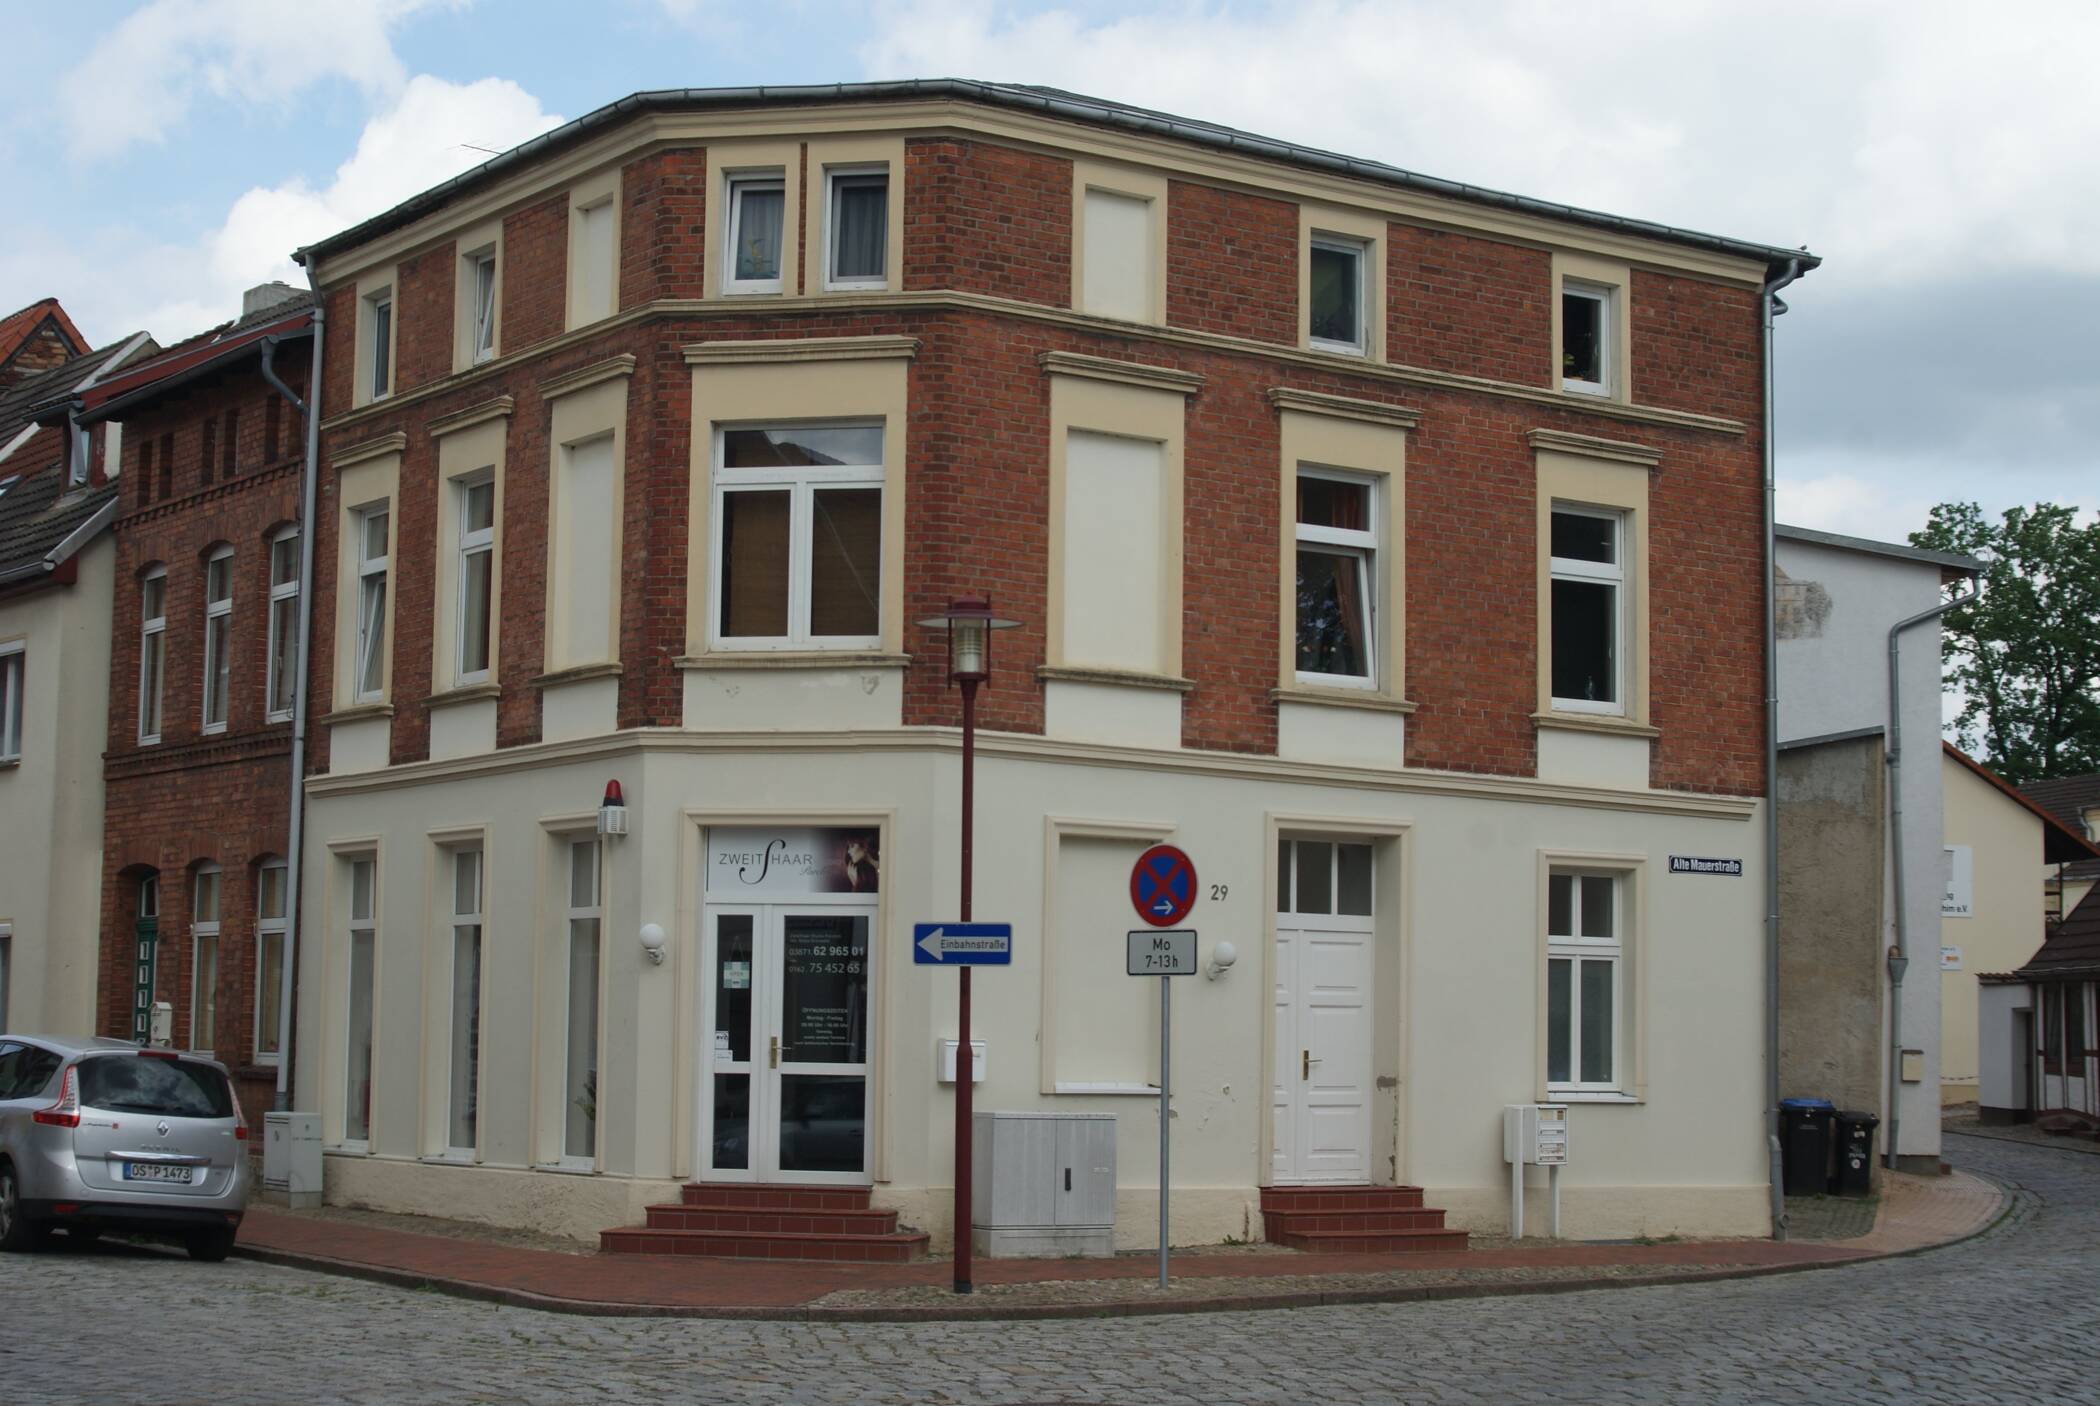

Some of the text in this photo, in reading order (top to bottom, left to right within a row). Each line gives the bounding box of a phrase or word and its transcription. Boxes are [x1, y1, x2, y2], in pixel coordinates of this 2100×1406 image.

[1673, 858, 1739, 873] Alte Mauerstraße
[1210, 884, 1229, 901] 29
[813, 946, 827, 956] 62
[829, 946, 849, 956] 965
[851, 946, 865, 956] 01
[940, 939, 1006, 950] Einbahnstraße
[1153, 938, 1171, 951] Mo
[810, 963, 823, 973] 75
[824, 963, 846, 974] 452
[847, 963, 860, 974] 65
[163, 1167, 191, 1180] 1473
